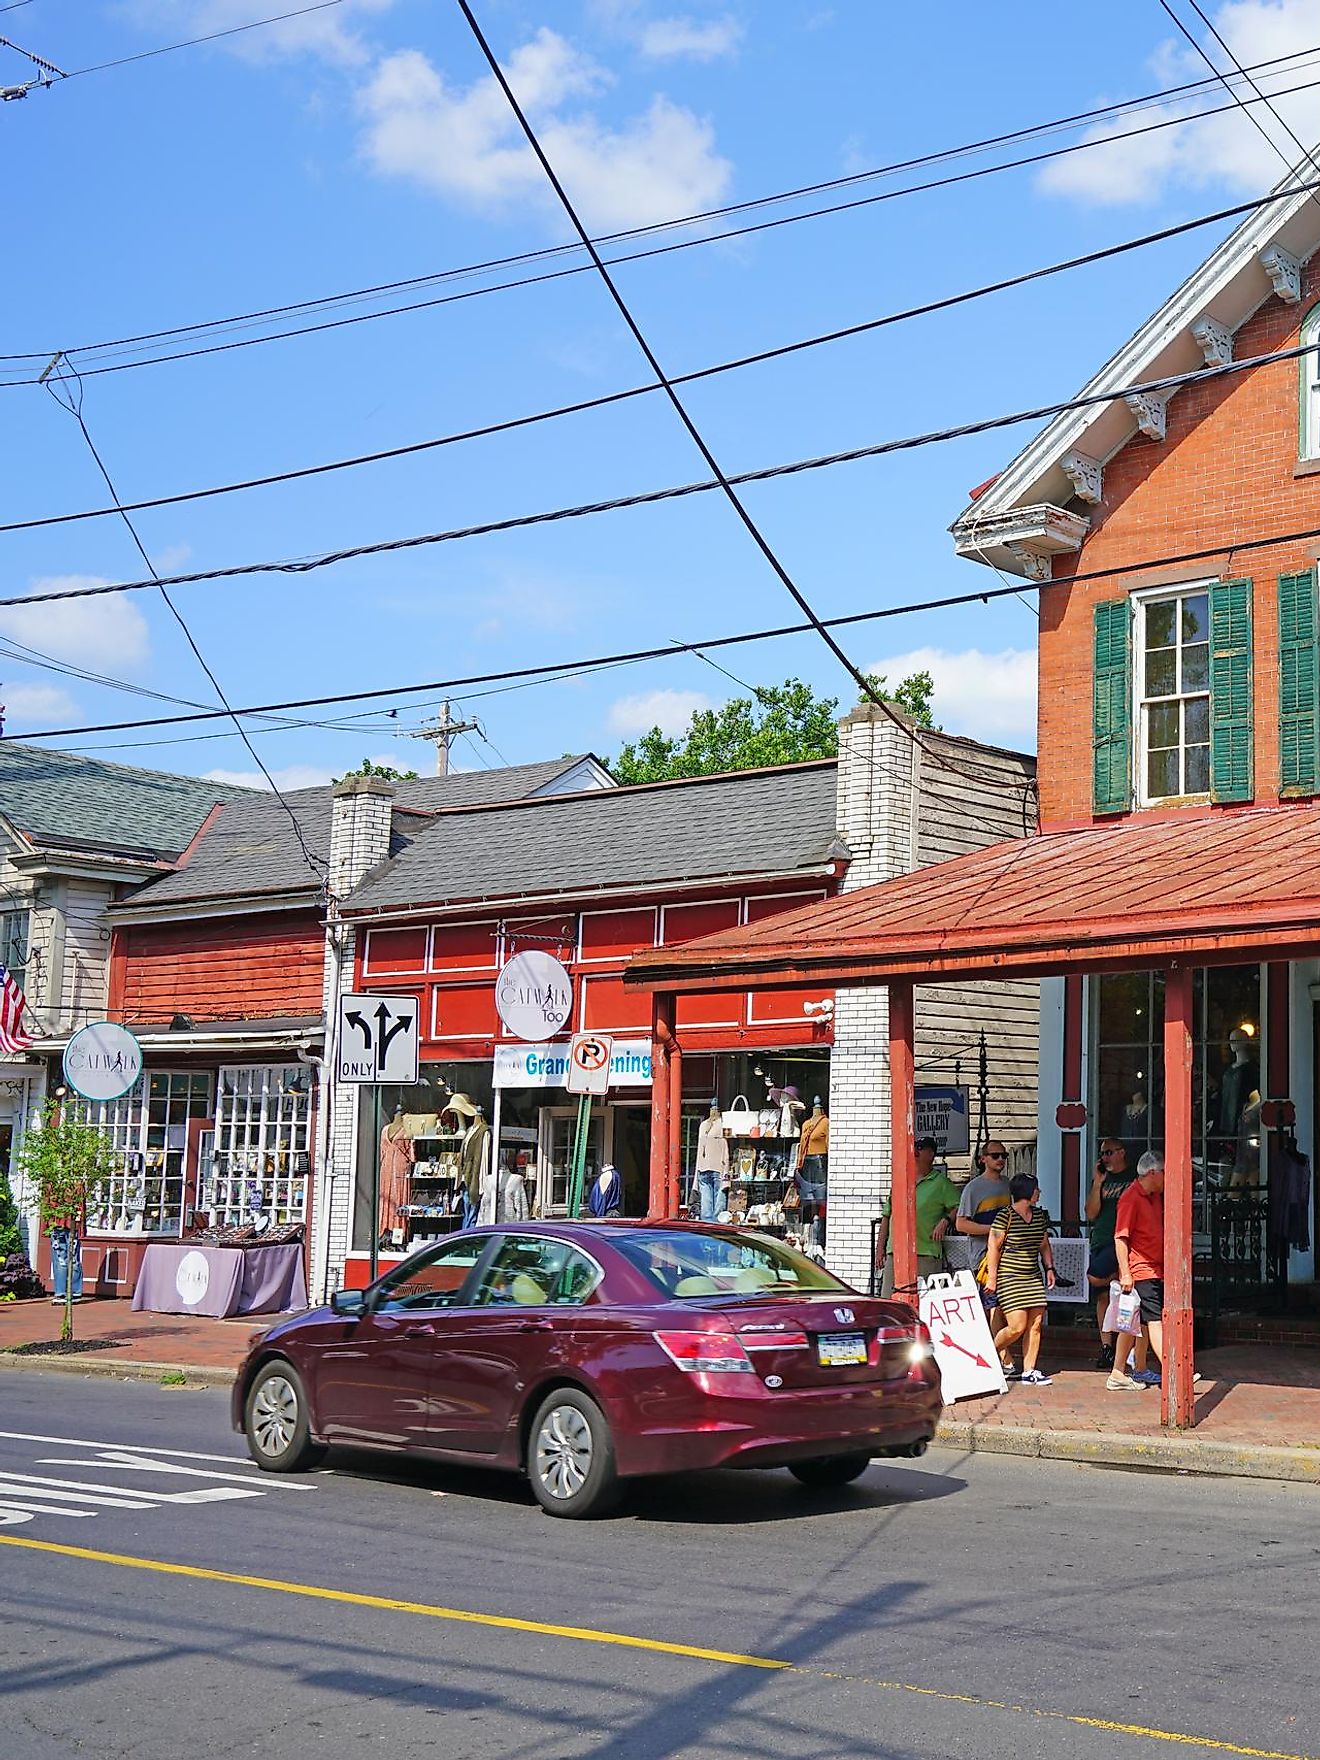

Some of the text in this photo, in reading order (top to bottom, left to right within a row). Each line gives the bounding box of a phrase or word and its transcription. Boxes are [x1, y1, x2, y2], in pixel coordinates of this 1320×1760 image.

[342, 1062, 373, 1076] ONLY
[917, 1113, 950, 1132] GALLERY
[929, 1296, 976, 1328] ART
